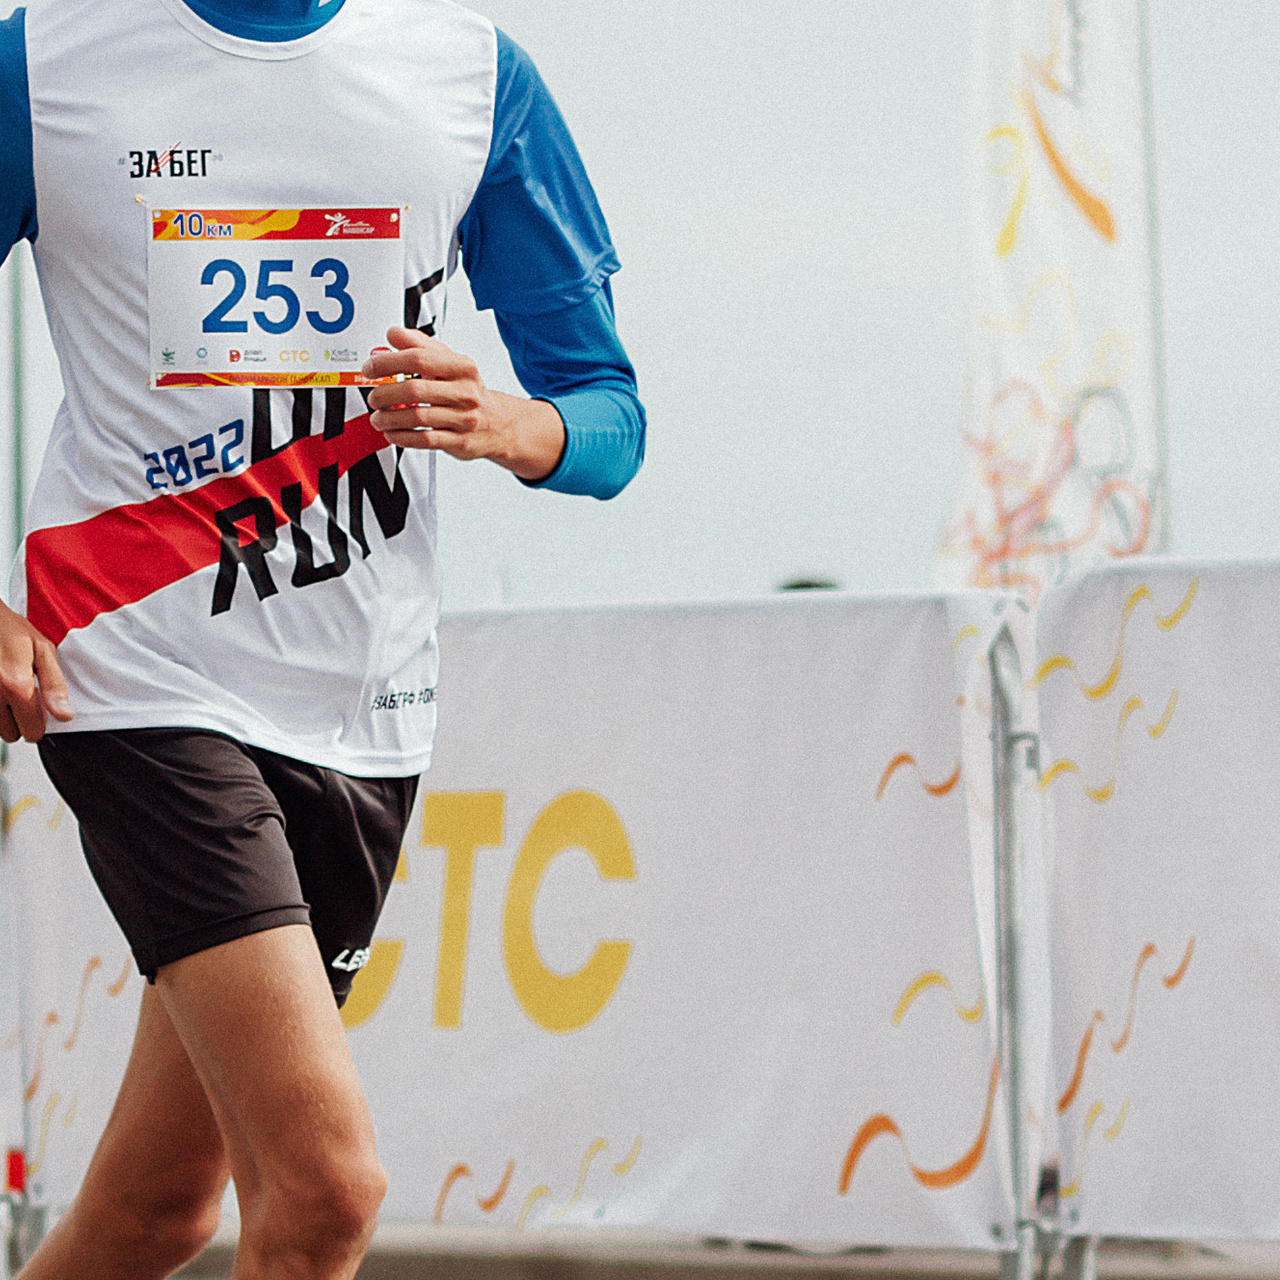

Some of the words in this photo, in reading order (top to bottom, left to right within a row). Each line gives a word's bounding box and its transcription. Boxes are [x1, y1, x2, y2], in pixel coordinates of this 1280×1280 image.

[172, 213, 203, 237] 10
[200, 258, 355, 334] 253
[144, 418, 245, 490] 2022
[210, 447, 410, 617] RUN
